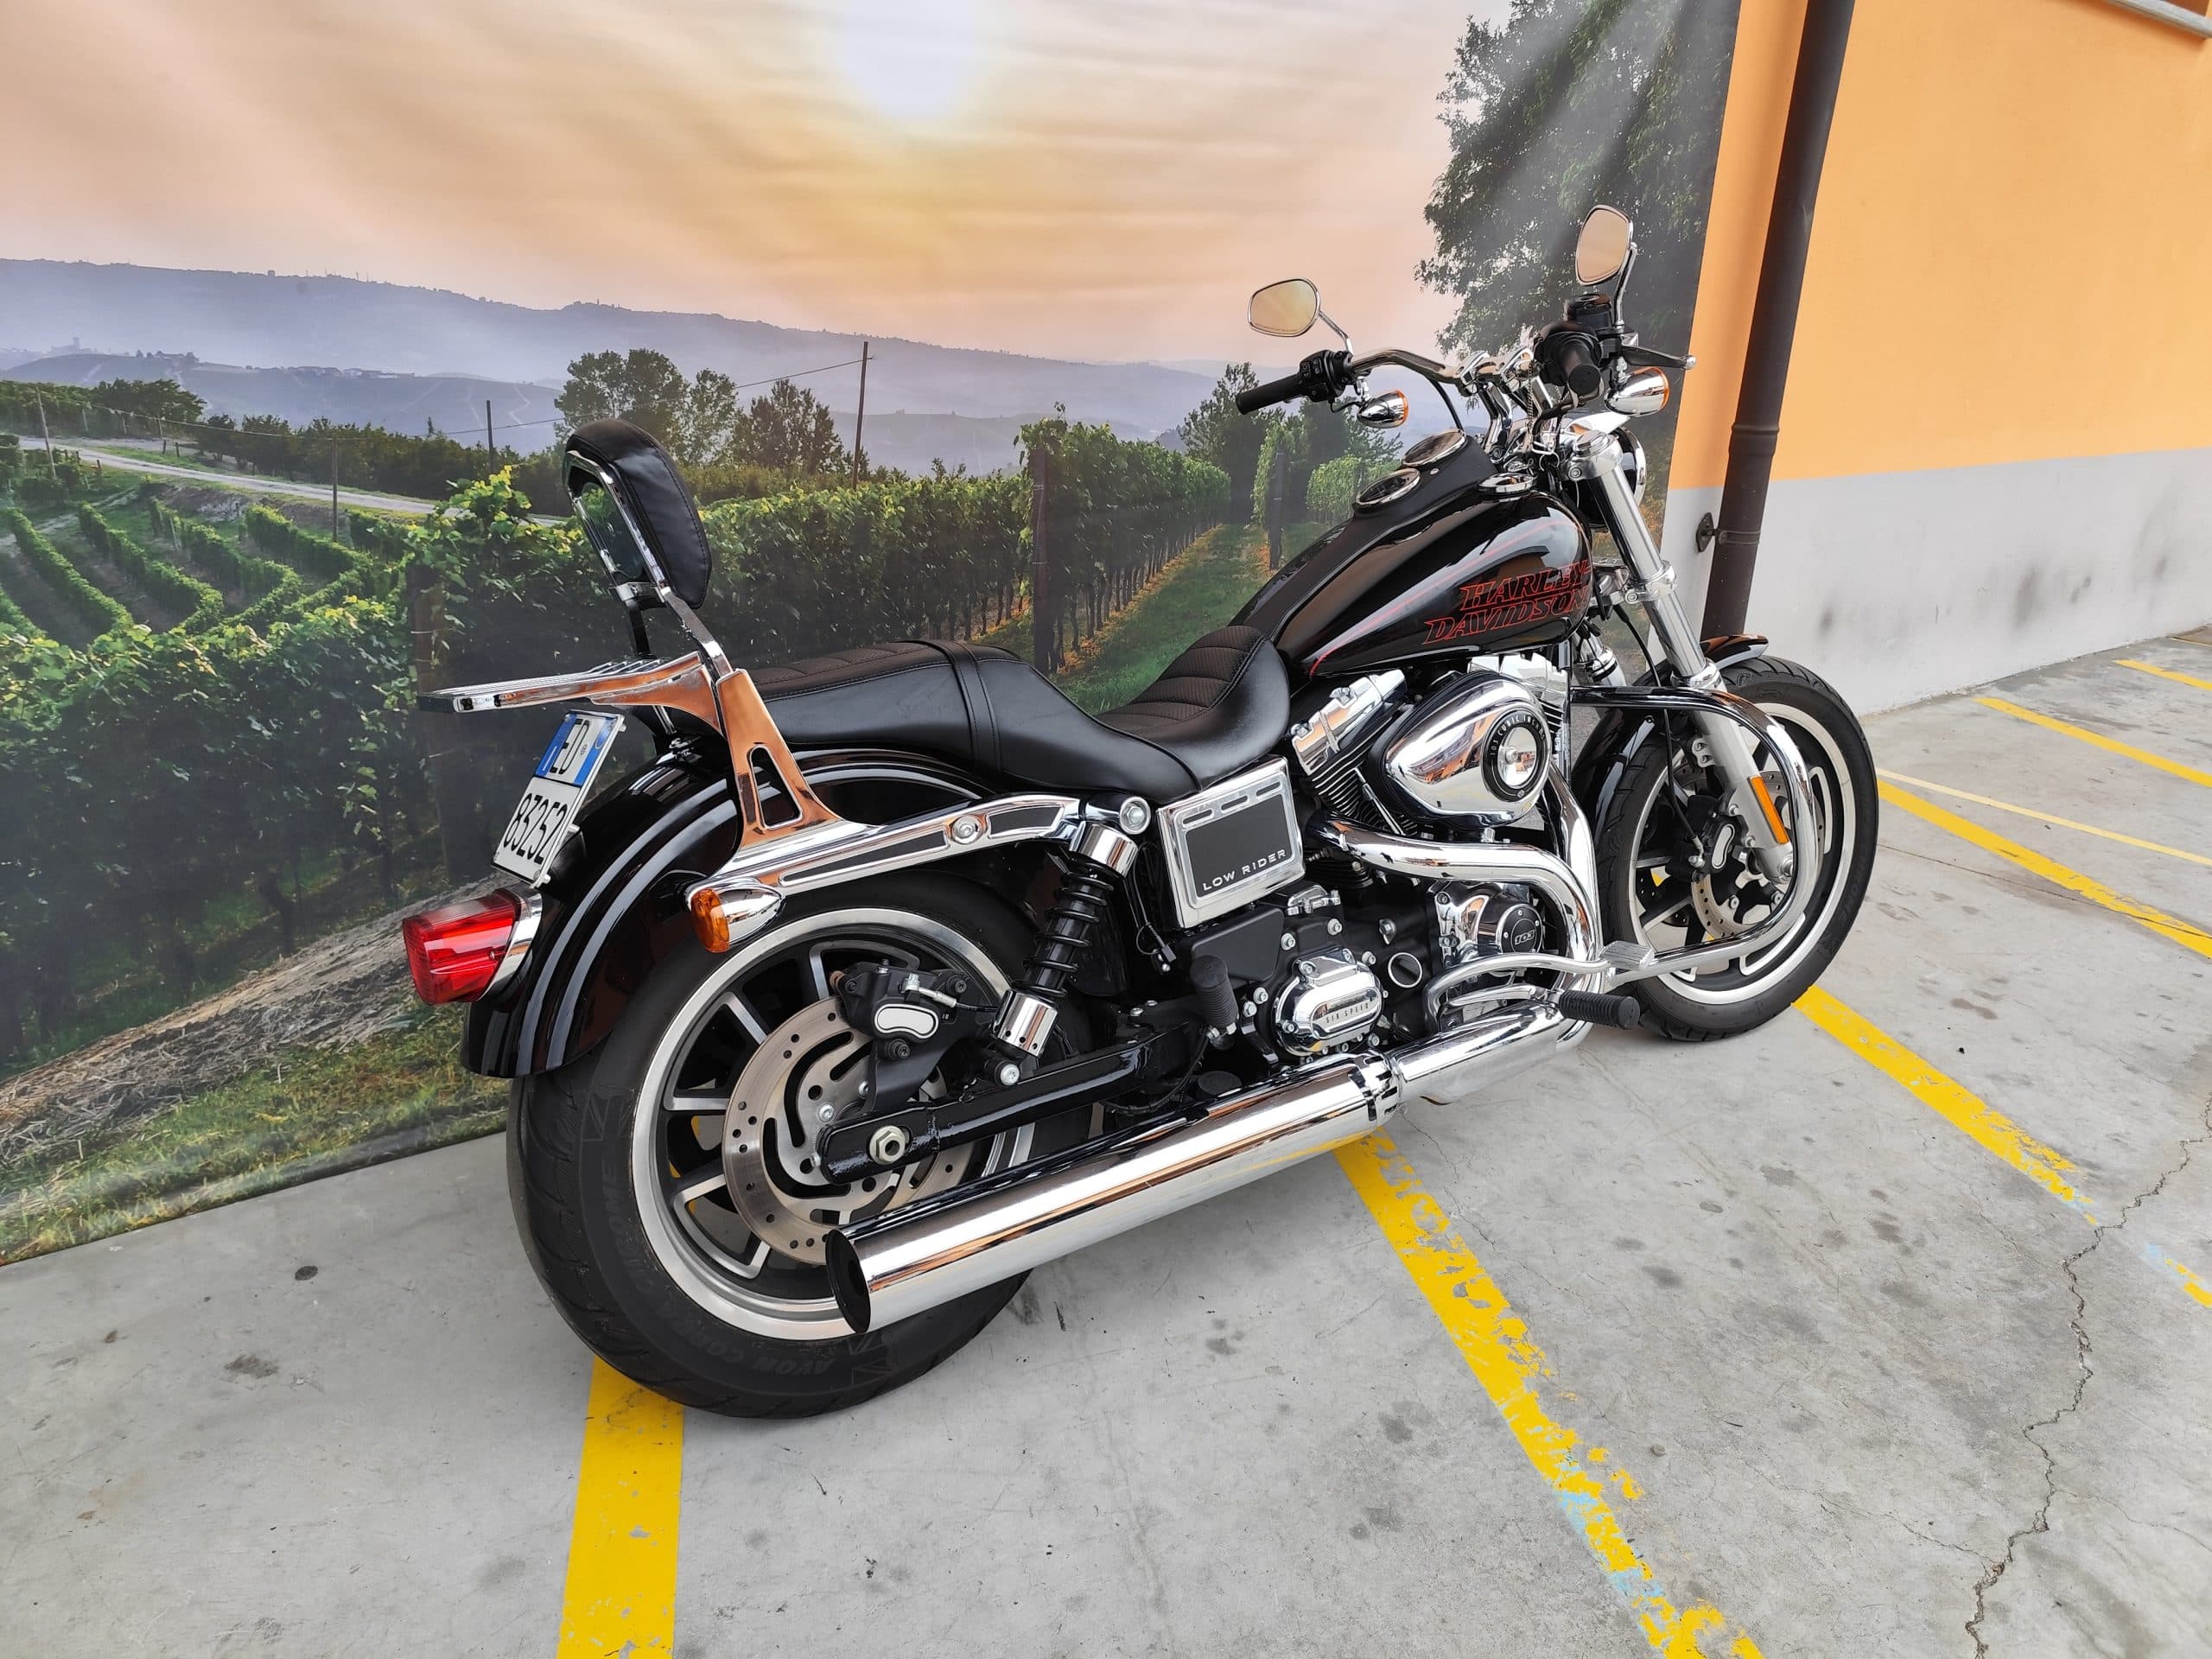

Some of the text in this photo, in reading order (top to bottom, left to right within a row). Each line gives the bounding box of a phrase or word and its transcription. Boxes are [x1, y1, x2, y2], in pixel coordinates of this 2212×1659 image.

[1422, 588, 1588, 645] DAVIDSON
[550, 718, 589, 774] ED
[504, 792, 568, 863] 83252
[1203, 849, 1286, 891] LOW RIDER
[1515, 929, 1535, 945] 103
